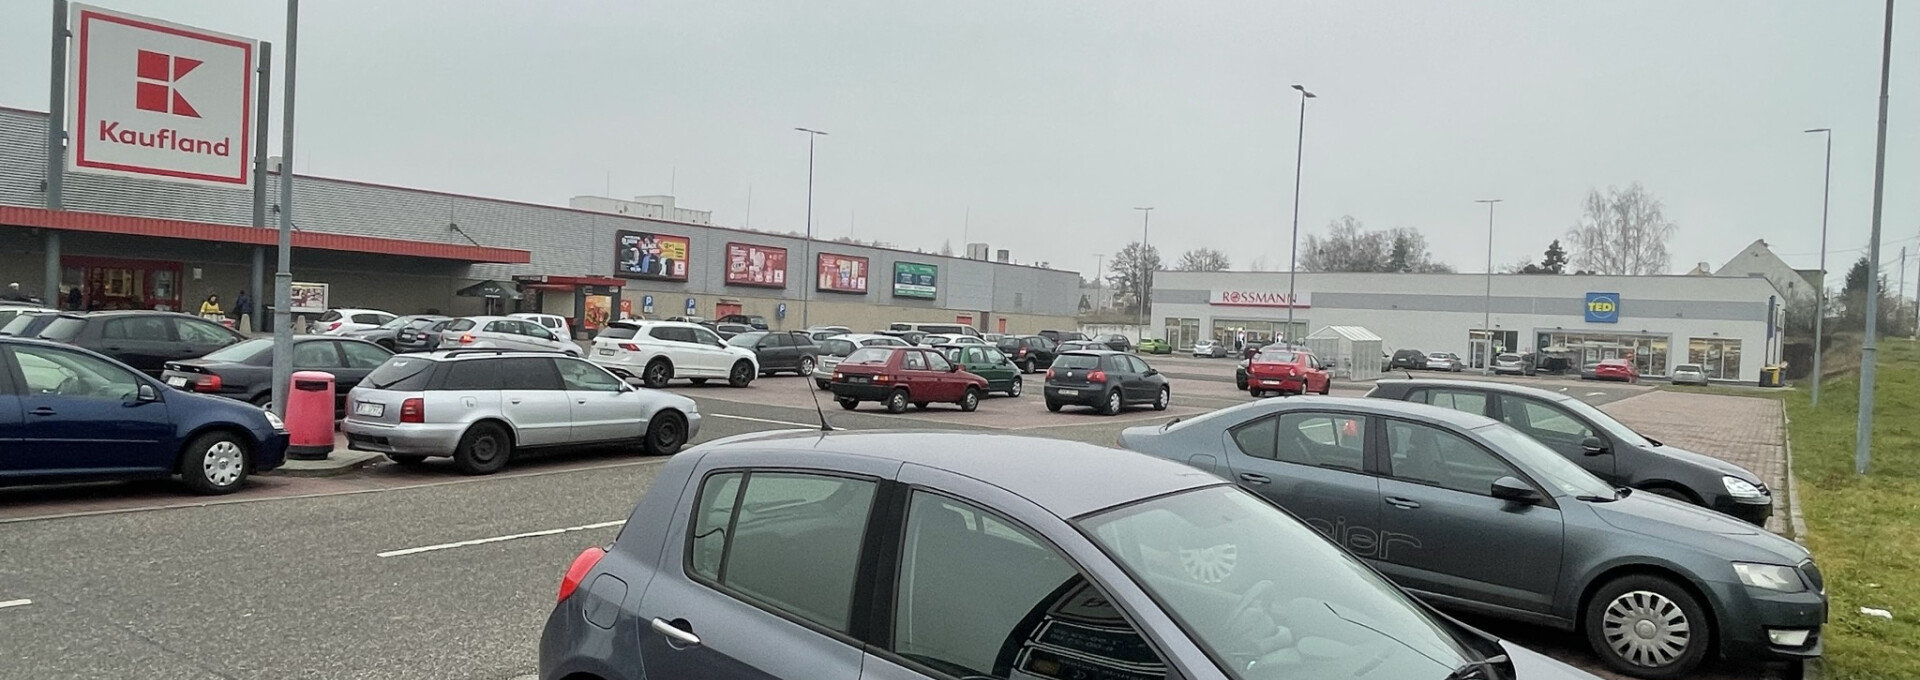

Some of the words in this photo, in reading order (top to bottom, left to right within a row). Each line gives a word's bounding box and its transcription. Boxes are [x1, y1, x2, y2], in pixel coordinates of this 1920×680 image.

[99, 120, 230, 157] Kaufland
[646, 296, 652, 305] P
[1222, 291, 1297, 303] ROSSMANN
